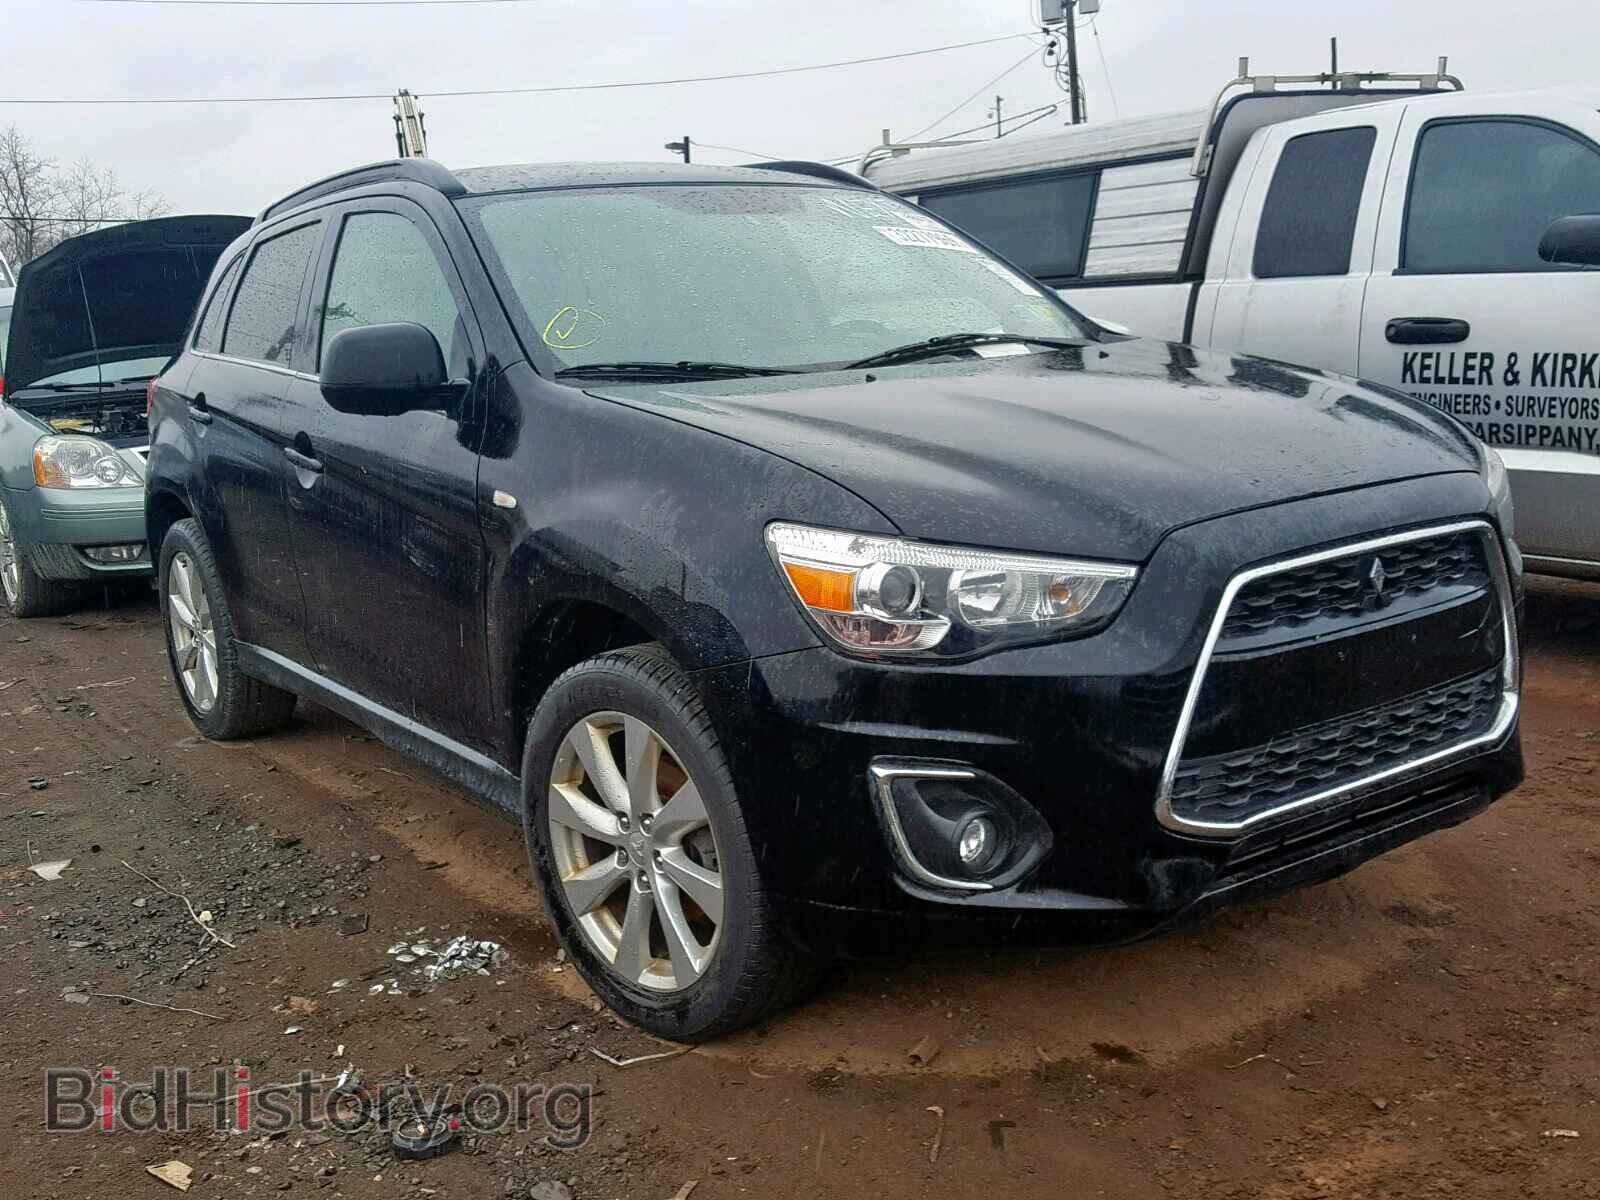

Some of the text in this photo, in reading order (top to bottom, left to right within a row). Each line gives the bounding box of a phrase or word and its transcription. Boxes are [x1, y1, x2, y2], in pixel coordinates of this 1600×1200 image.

[1401, 351, 1600, 389] KELLER & KIRK
[1408, 391, 1600, 420] GINEERS SURVEYORS
[1465, 421, 1600, 456] ARSIPPANY,
